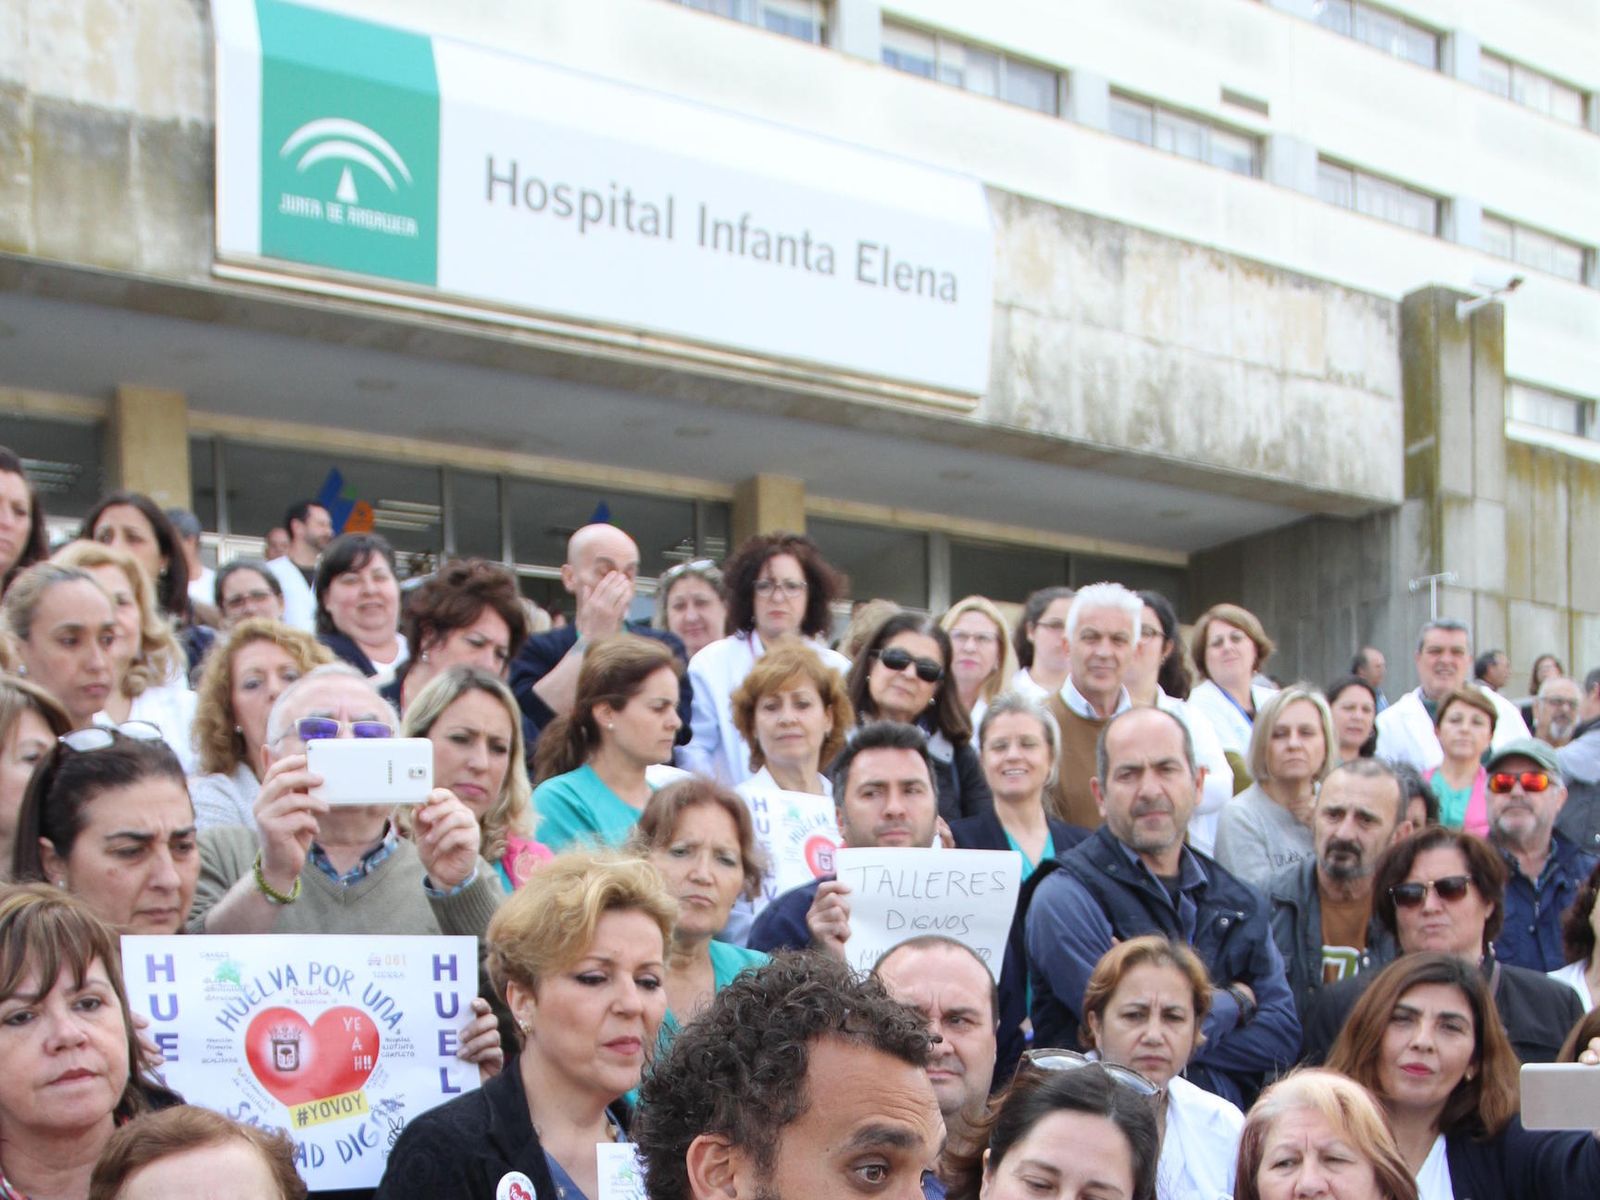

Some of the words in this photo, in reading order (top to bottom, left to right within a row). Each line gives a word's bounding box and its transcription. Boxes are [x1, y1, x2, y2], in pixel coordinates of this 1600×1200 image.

[485, 154, 675, 240] Hospital
[698, 200, 836, 277] Infanta
[854, 240, 959, 304] Elena
[845, 864, 1006, 899] TALLERES
[886, 909, 975, 935] DIGNOS
[216, 963, 299, 1032] HUELVA
[308, 961, 355, 996] POR
[297, 1092, 362, 1126] #YOVOY
